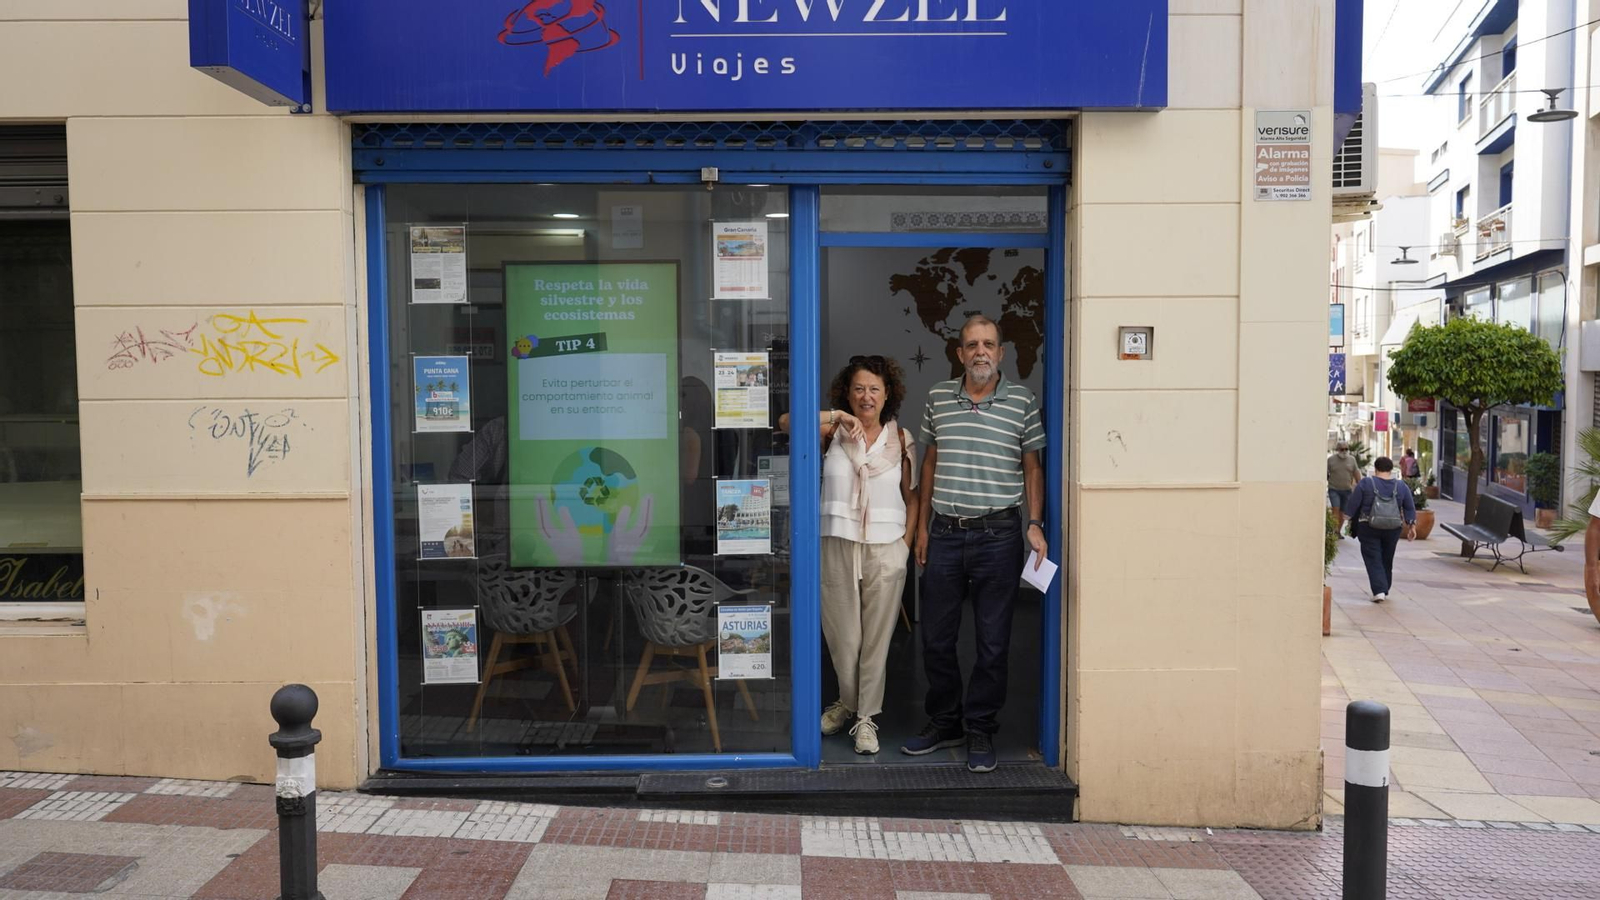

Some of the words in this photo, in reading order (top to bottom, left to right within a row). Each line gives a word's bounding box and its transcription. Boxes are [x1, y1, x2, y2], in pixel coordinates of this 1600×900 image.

[671, 53, 796, 81] Viajes
[1258, 126, 1309, 136] verisure
[1257, 147, 1309, 159] Alarma
[1257, 174, 1278, 182] Aviso
[533, 279, 594, 293] Respeta
[598, 279, 613, 291] la
[617, 279, 649, 291] vida
[540, 294, 604, 306] silvestre
[607, 296, 618, 308] y
[621, 294, 644, 306] los
[544, 309, 636, 321] ecosistemas
[555, 339, 582, 353] TIP
[586, 338, 596, 350] 4
[542, 379, 568, 388] Evita
[570, 379, 621, 391] perturbar
[623, 379, 634, 387] el
[522, 391, 614, 404] comportamiento
[616, 391, 654, 401] animal
[550, 406, 565, 415] en
[566, 406, 580, 415] su
[582, 405, 627, 415] entorno.
[0, 557, 84, 599] Isabel
[722, 620, 768, 631] ASTURIAS
